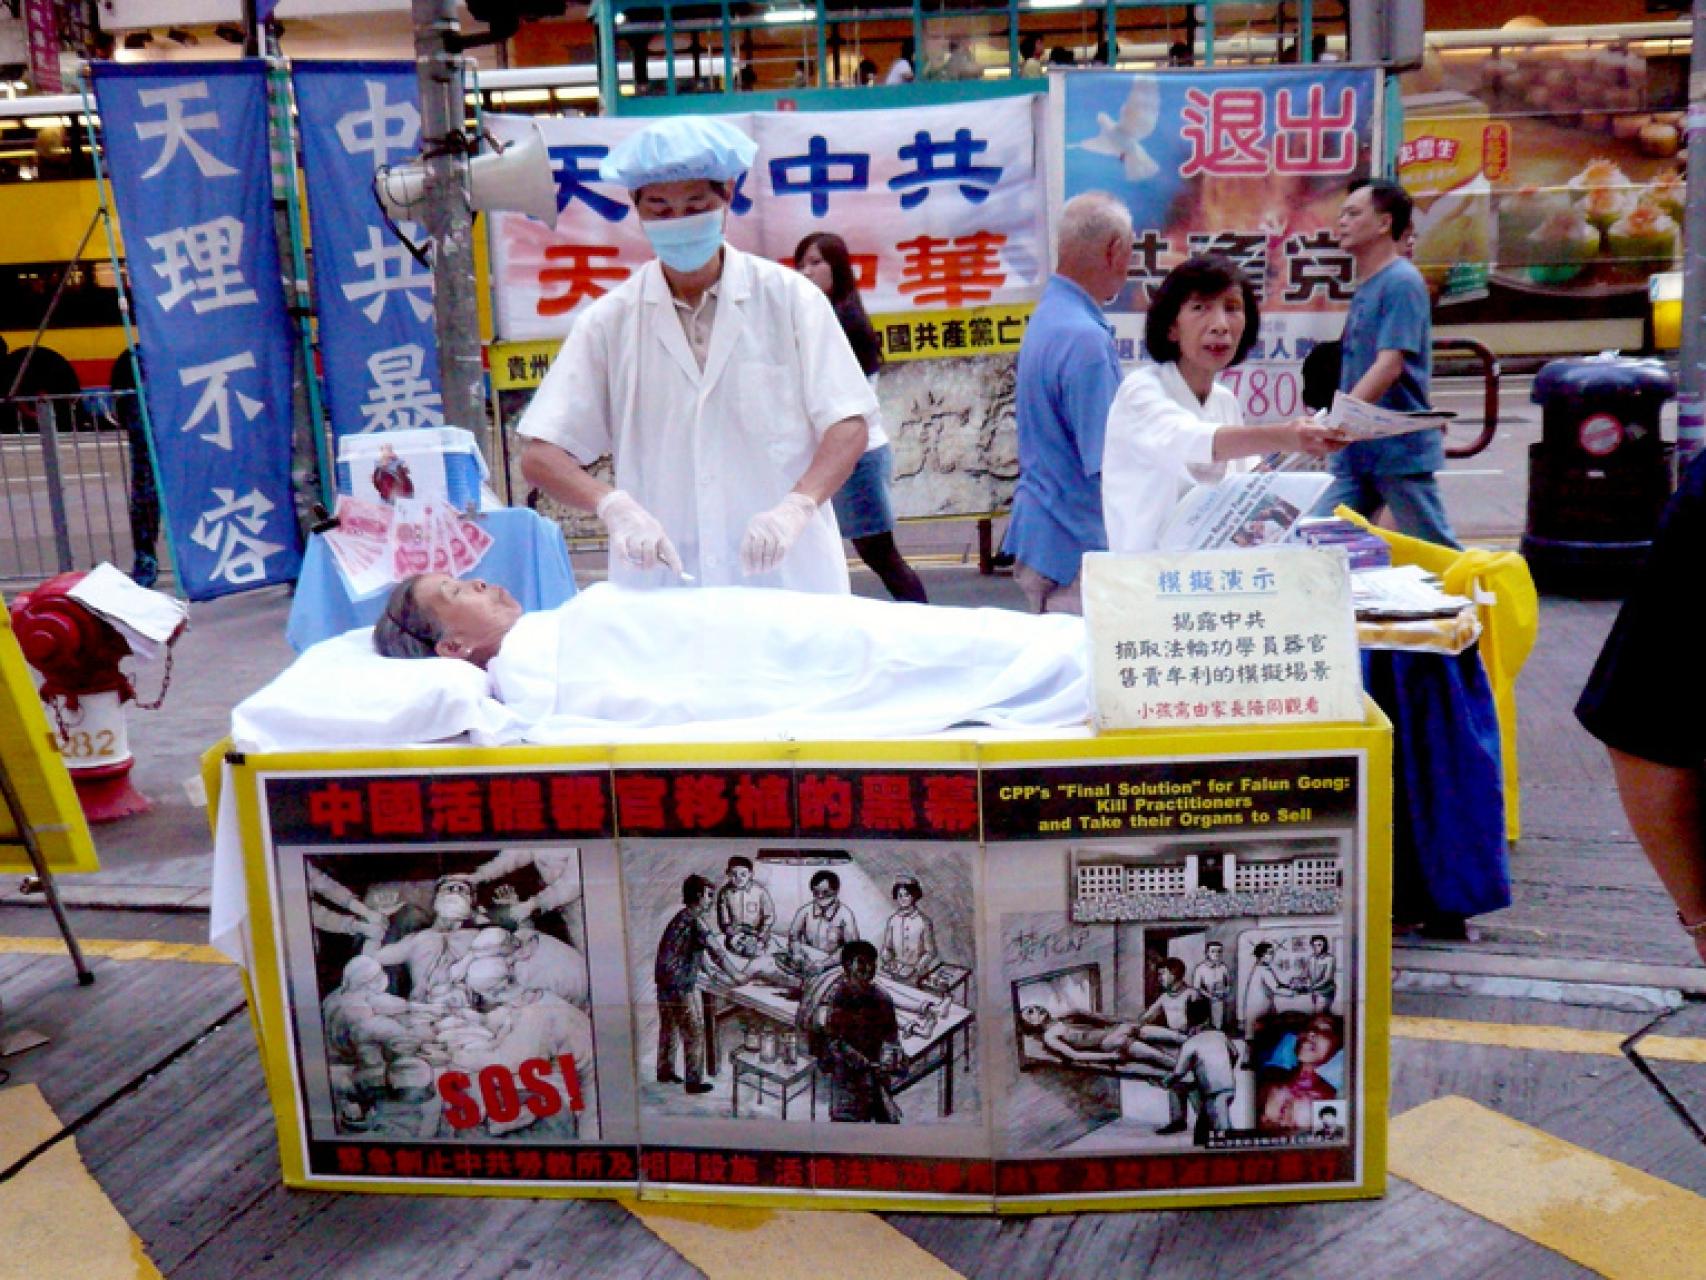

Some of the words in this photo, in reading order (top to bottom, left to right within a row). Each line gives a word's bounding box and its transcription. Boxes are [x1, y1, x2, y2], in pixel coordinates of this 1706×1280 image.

[1179, 84, 1357, 178] 退出
[134, 80, 286, 584] 天理不容
[1157, 566, 1276, 593] 模擬演示
[1172, 609, 1266, 632] 揭露中共
[999, 785, 1050, 800] CPP's
[1207, 778, 1234, 793] for
[1240, 776, 1290, 792] Falun
[1297, 775, 1350, 792] Gong:
[308, 771, 979, 839] 中國活體器官移植的黑幕
[1097, 798, 1128, 813] Kill
[1135, 796, 1252, 813] Practitioners
[1038, 816, 1072, 831] and
[1079, 814, 1123, 830] Take
[1129, 813, 1173, 828] their
[1179, 811, 1244, 829] Organs
[1251, 809, 1270, 823] to
[1277, 807, 1313, 823] Sell
[438, 1052, 585, 1130] SOS!
